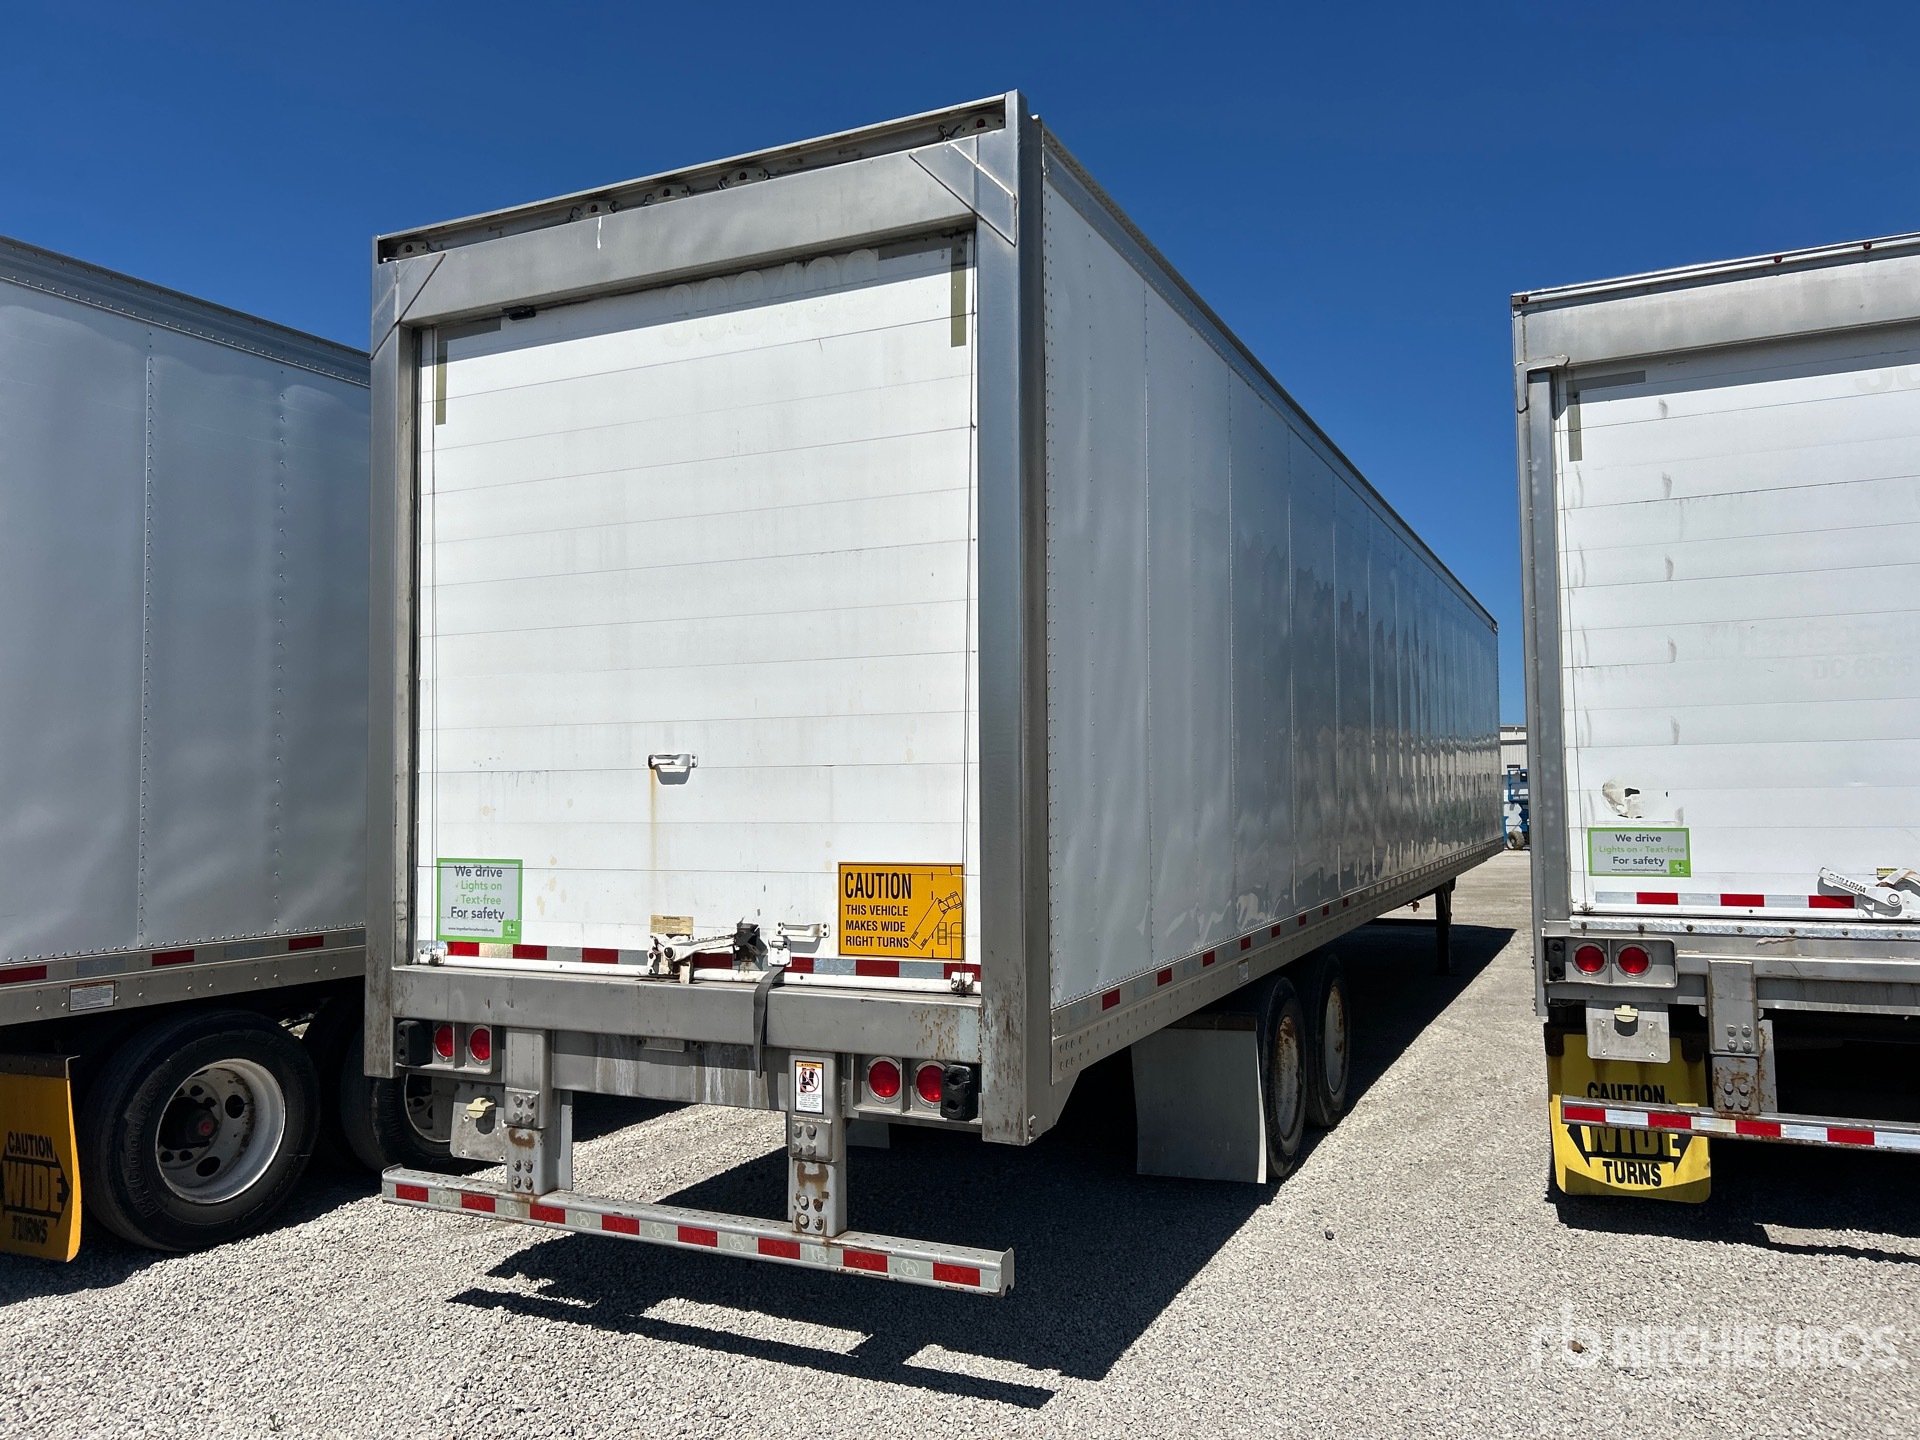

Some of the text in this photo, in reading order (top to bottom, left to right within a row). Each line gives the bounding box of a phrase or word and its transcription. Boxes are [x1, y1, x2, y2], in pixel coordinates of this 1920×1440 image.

[1615, 833, 1662, 842] We drive
[1599, 846, 1625, 854] Lights
[1645, 845, 1685, 853] Text-free
[1612, 856, 1665, 867] For safety
[454, 864, 503, 878] We drive
[461, 880, 503, 892] Lights on
[845, 871, 912, 900] CAUTION
[461, 894, 502, 905] Text-free
[451, 906, 505, 923] For safety
[845, 904, 909, 917] THIS VEHICLE
[845, 920, 906, 932] MAKES WIDE
[845, 935, 910, 948] RIGHT TURNS
[1587, 1082, 1665, 1104] CAUTION
[7, 1130, 54, 1159] CAUTION
[1602, 1161, 1662, 1187] TURNS
[2, 1160, 63, 1213] WIDE
[12, 1214, 49, 1245] TURNS
